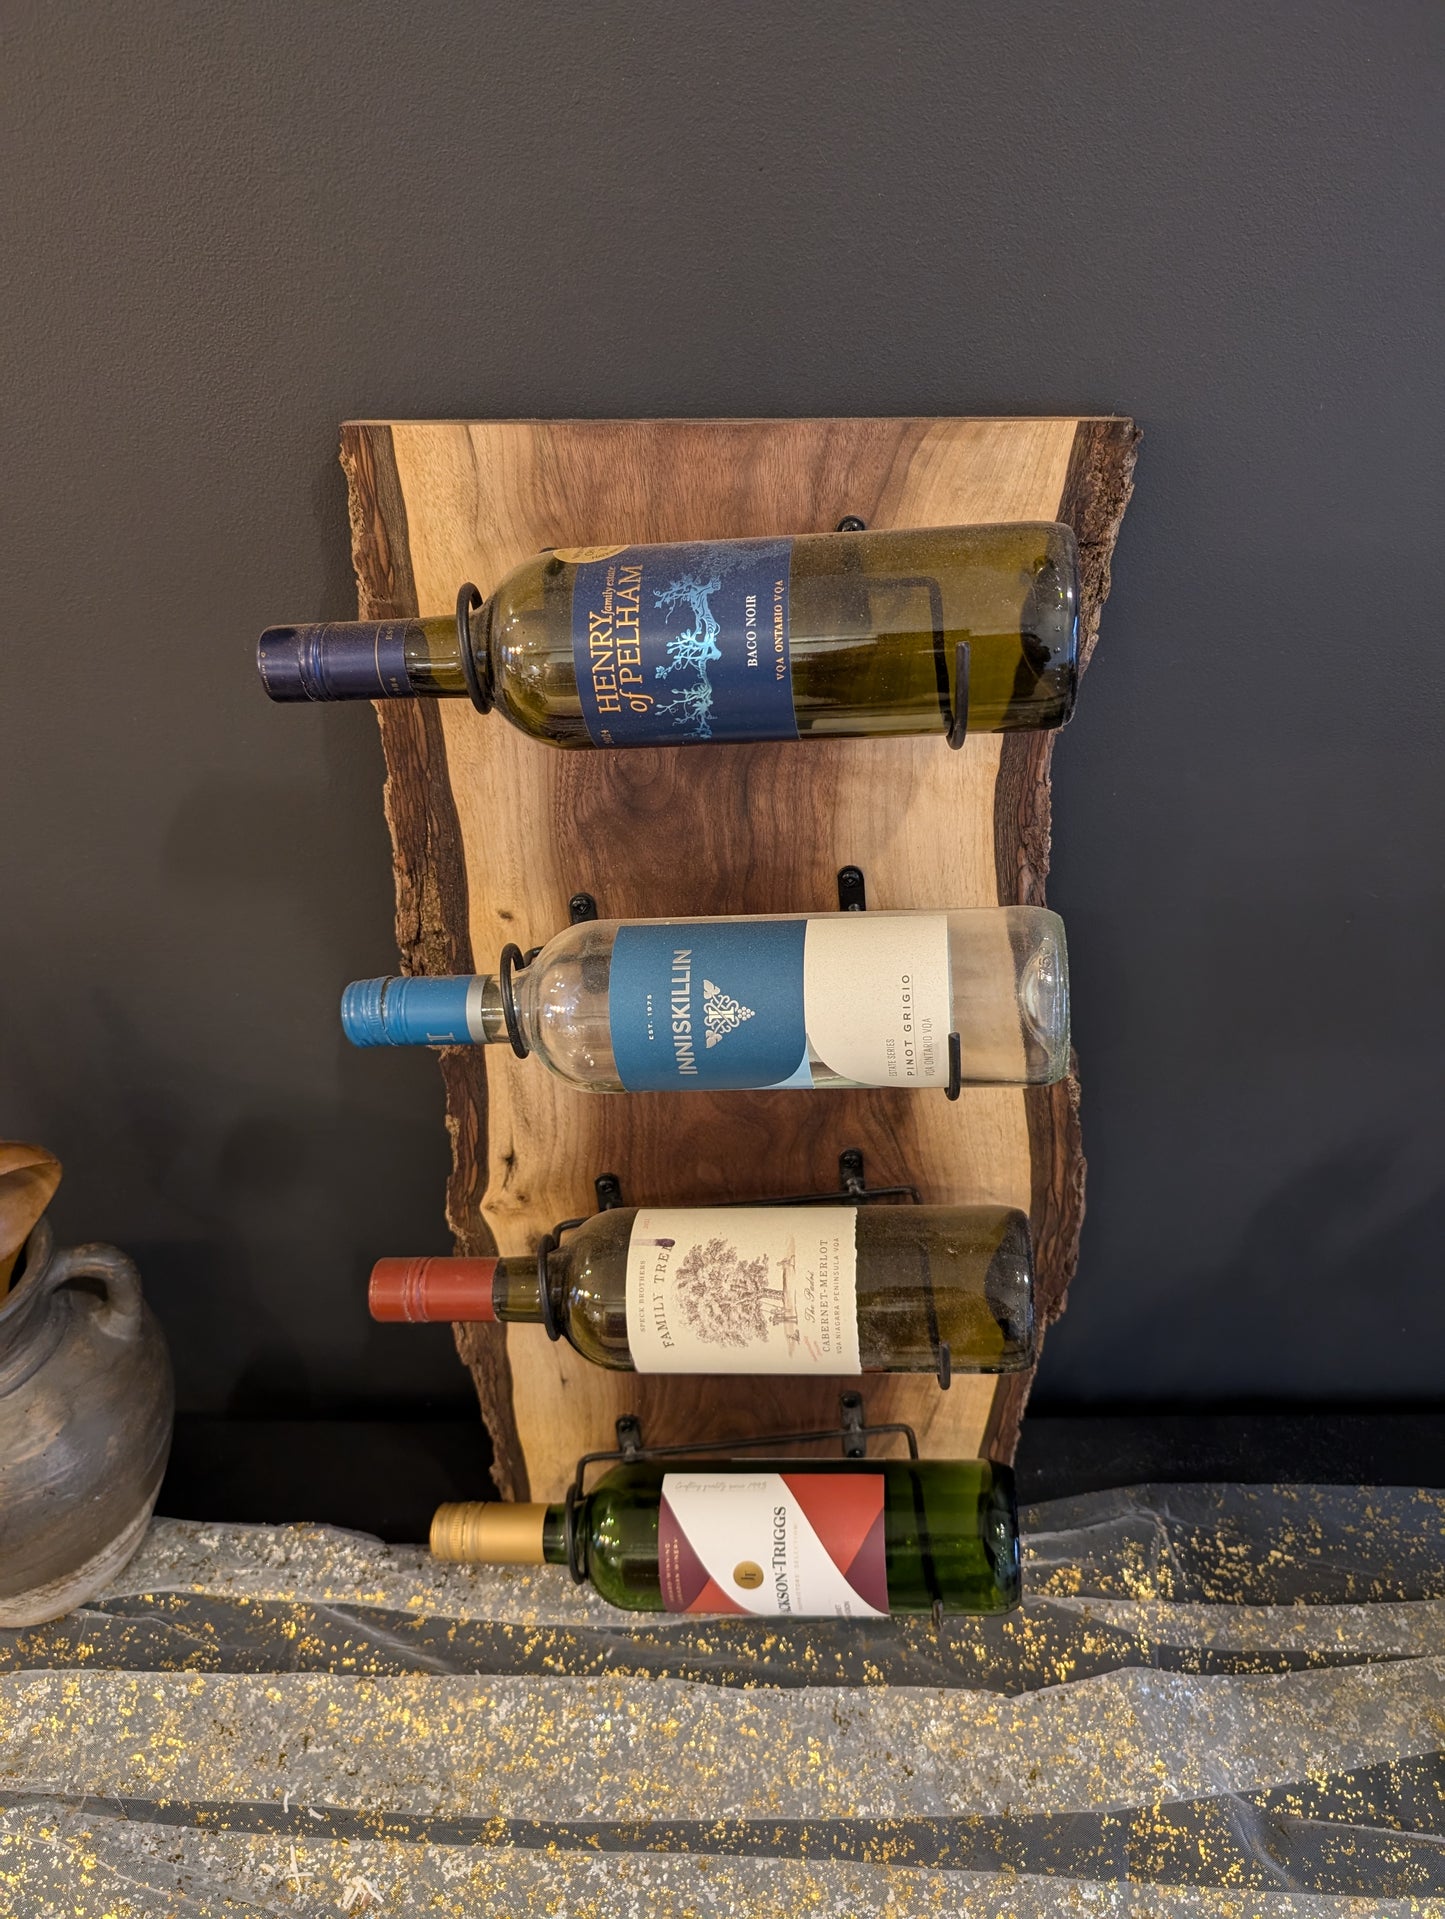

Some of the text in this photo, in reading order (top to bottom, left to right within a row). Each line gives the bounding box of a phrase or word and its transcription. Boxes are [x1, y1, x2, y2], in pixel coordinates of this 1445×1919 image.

[589, 566, 622, 714] HENRY family estate
[616, 564, 653, 713] of PELHAM
[746, 595, 758, 667] BACO NOIR
[774, 580, 785, 680] VQA ONTARIO VQA
[671, 949, 698, 1075] INNISKILLIN
[901, 974, 915, 1076] PINOT GRIGIO
[922, 1018, 932, 1033] VQA
[923, 1036, 934, 1065] ONTARIO
[886, 1039, 897, 1077] ESTATE SERIES
[653, 1293, 675, 1348] FAMILY
[804, 1305, 815, 1323] The
[820, 1239, 830, 1352] CABERNET-MERLOT
